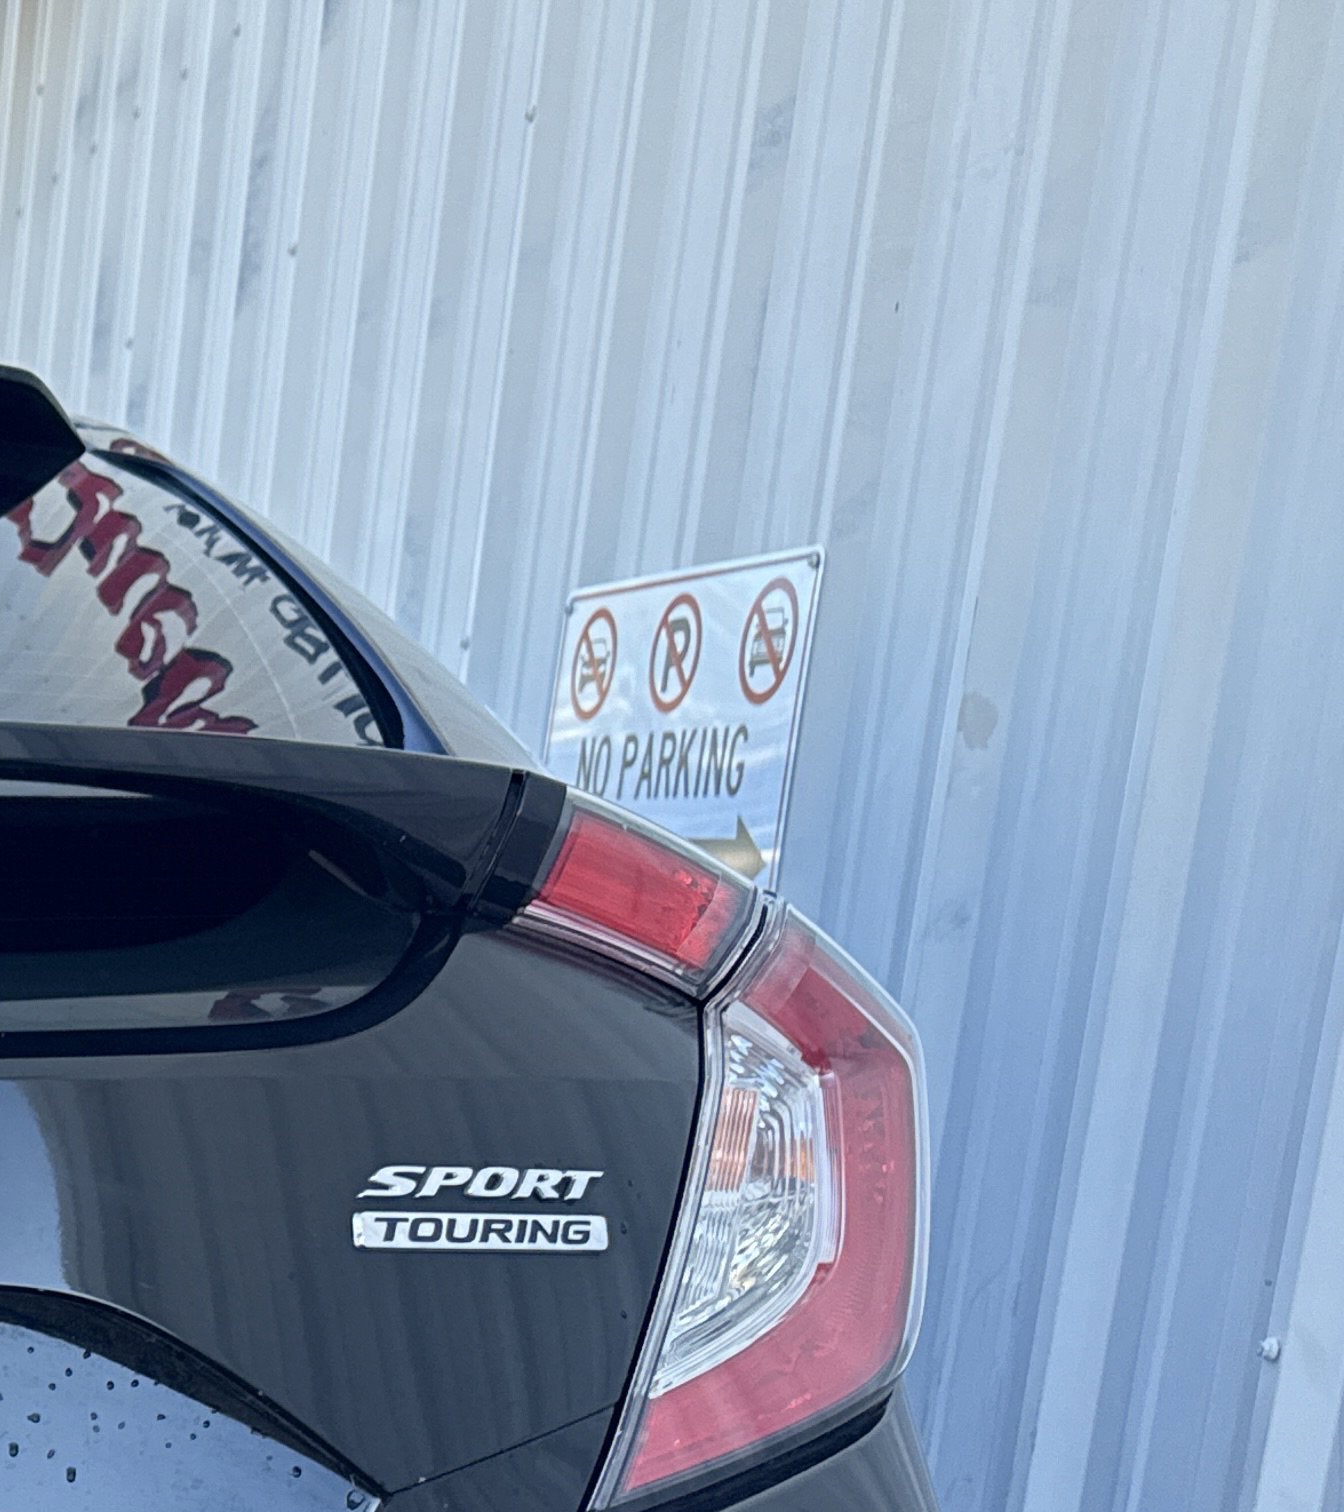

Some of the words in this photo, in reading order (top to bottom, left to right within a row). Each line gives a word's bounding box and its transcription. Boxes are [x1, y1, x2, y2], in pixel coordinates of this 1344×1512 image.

[576, 736, 611, 797] NO
[616, 723, 748, 800] PARKING
[355, 1165, 604, 1202] SPORT
[373, 1216, 592, 1246] TOURING
